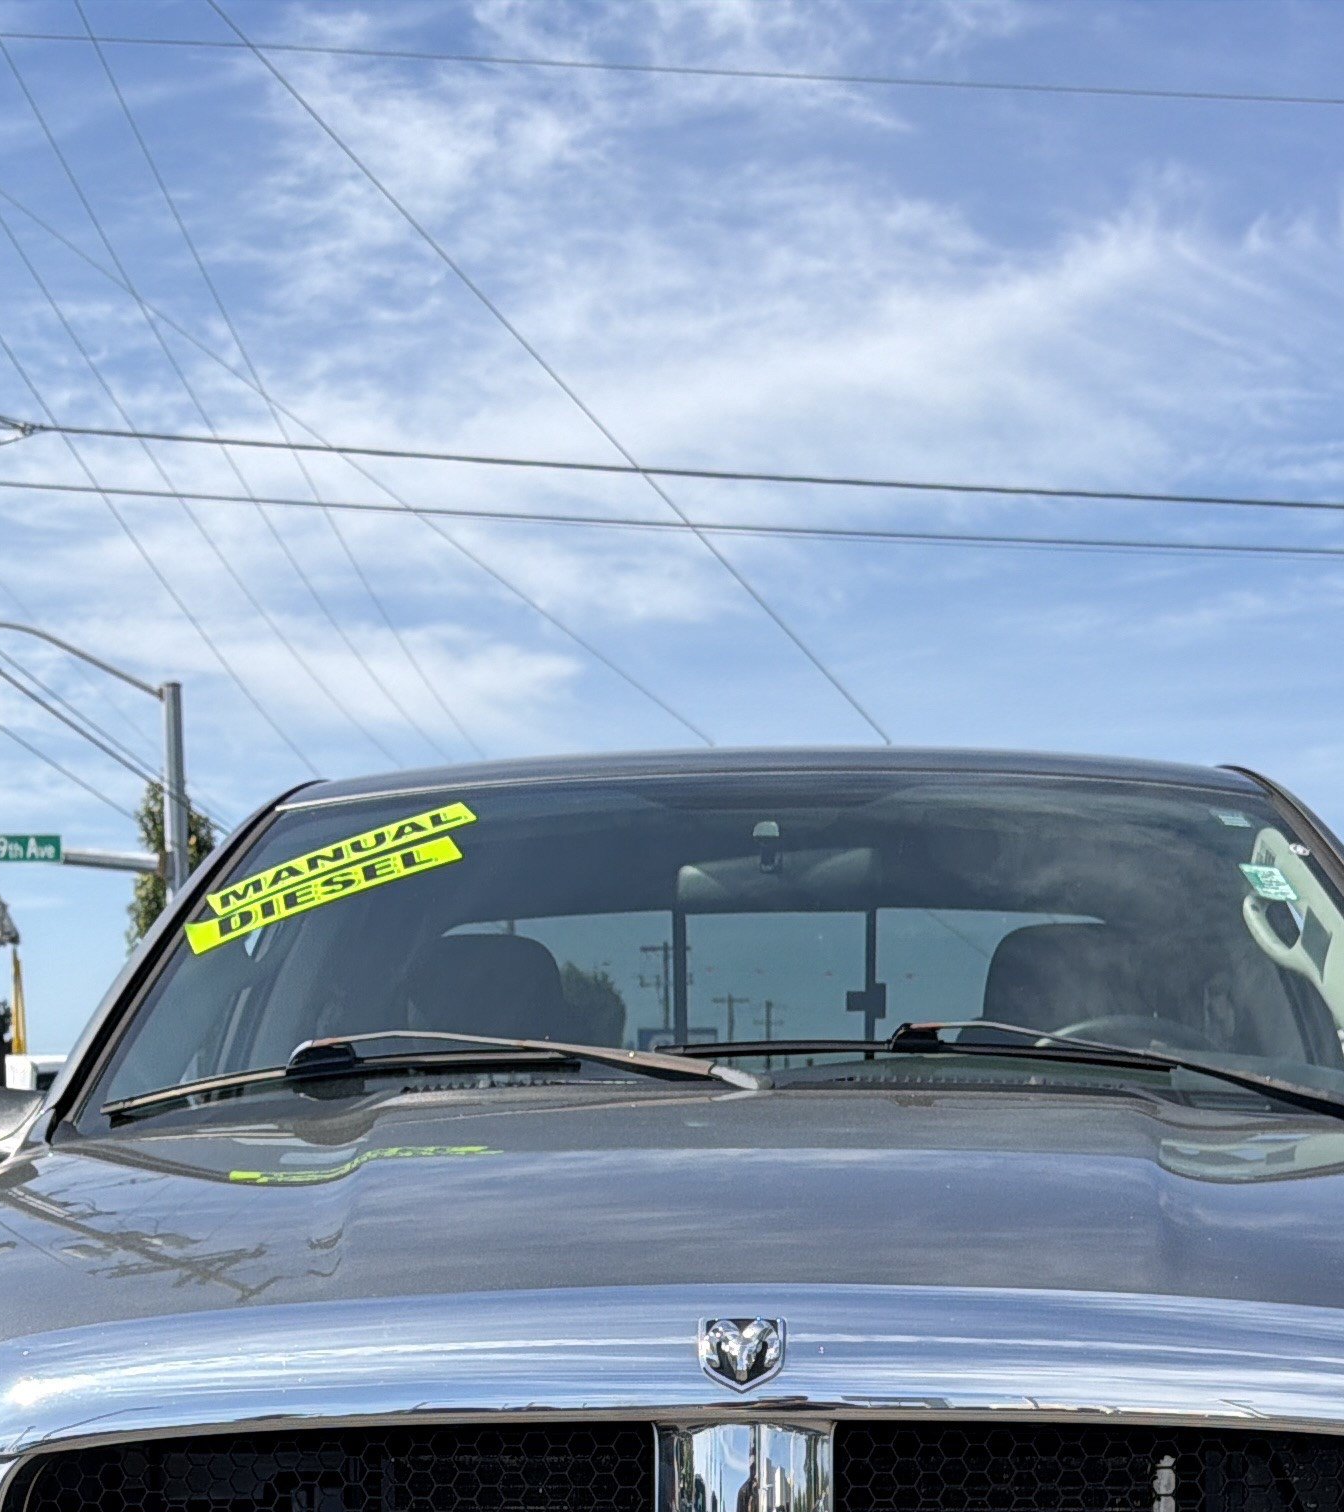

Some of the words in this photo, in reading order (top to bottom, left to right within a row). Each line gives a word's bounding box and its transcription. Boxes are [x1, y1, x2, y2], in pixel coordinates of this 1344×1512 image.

[26, 837, 56, 859] Ave
[220, 813, 465, 909] MANUAL
[218, 849, 438, 938] DIESEL
